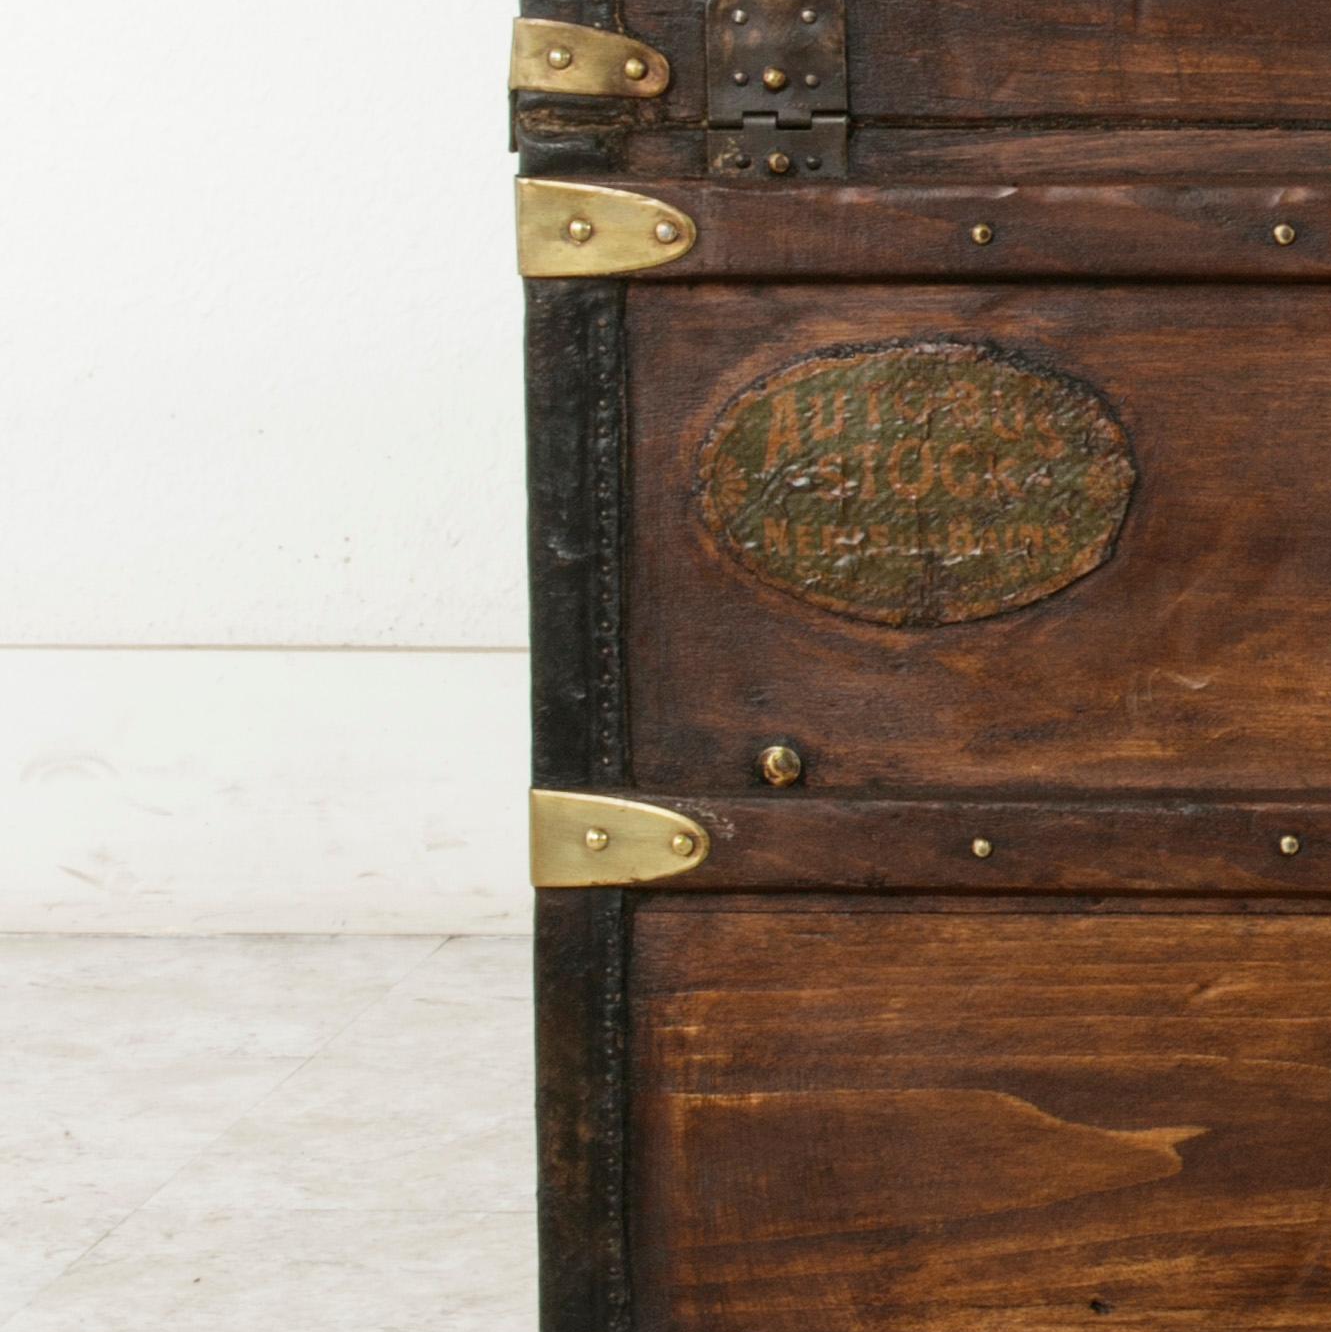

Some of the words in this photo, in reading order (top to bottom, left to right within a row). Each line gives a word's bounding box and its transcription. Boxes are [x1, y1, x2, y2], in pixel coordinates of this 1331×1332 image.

[763, 380, 1066, 472] AUTOBUS
[815, 437, 1027, 503] STOCK
[947, 514, 1072, 556] BAINS
